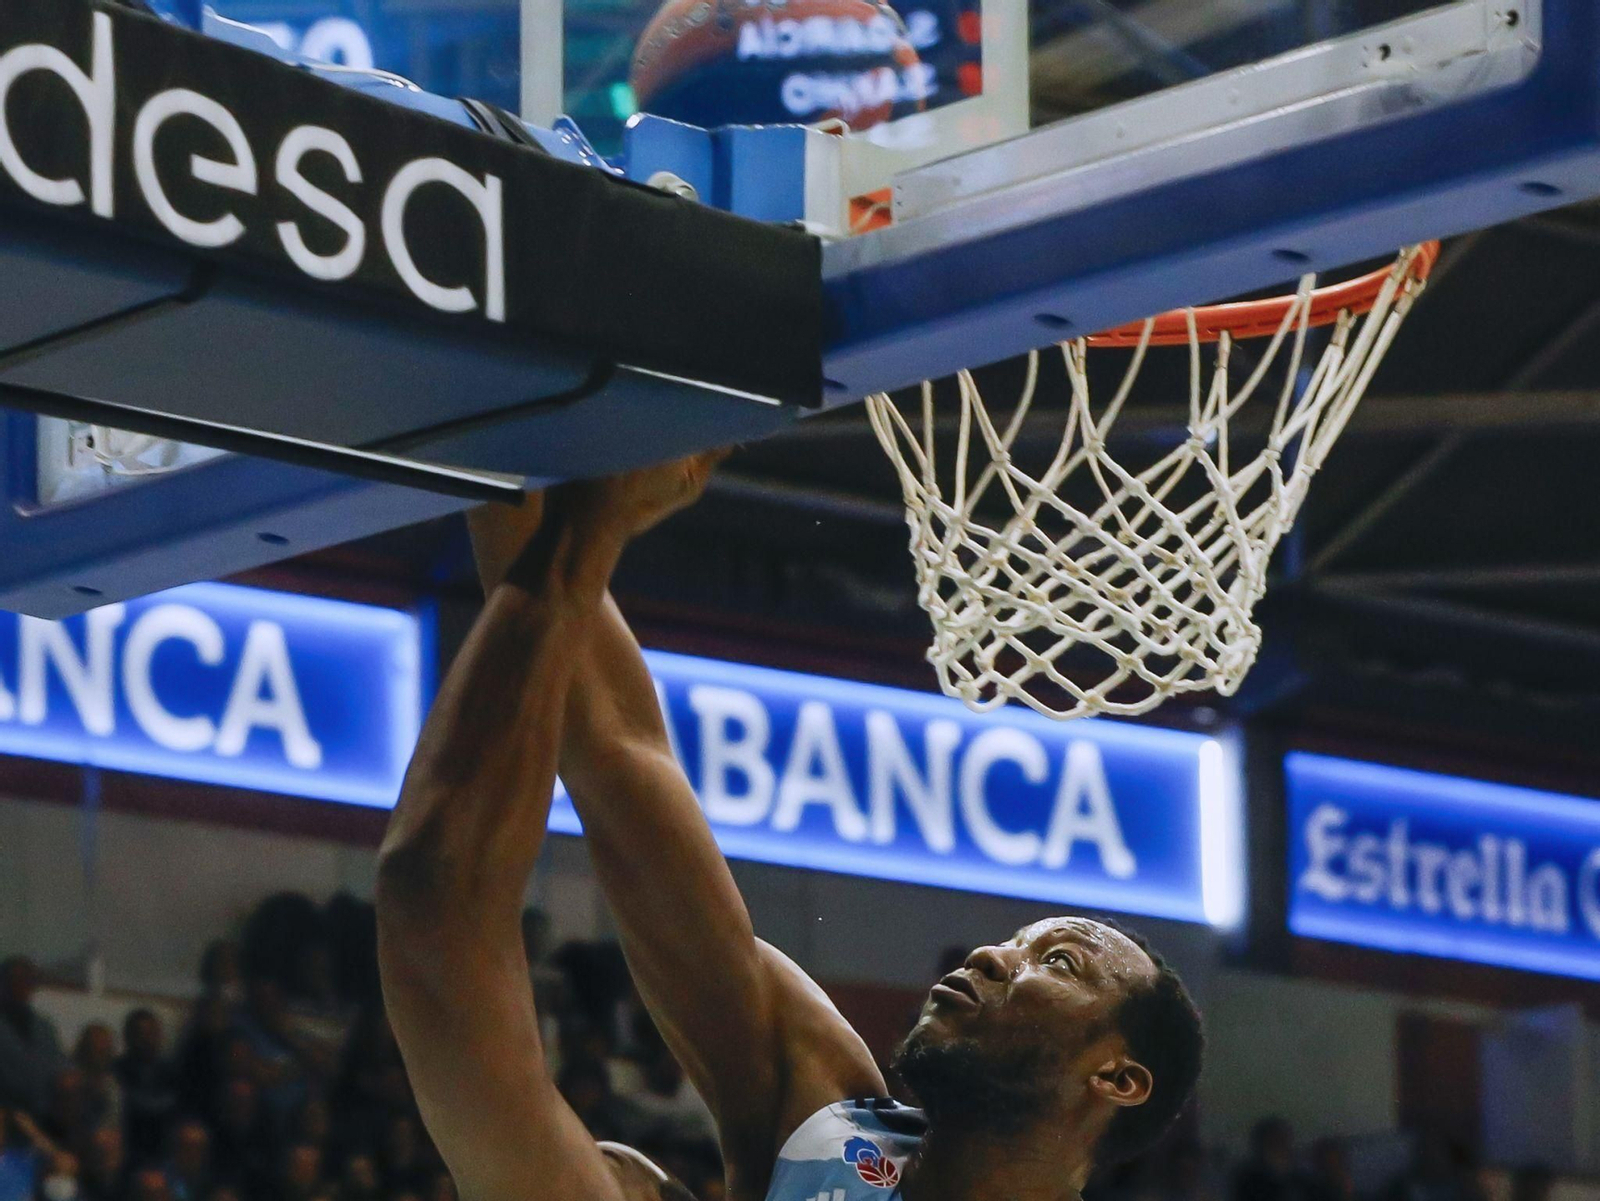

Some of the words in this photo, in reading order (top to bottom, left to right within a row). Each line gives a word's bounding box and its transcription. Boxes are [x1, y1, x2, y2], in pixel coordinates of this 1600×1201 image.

[0, 13, 505, 323] desa
[0, 601, 322, 769] NCA
[1302, 803, 1569, 933] Estrella
